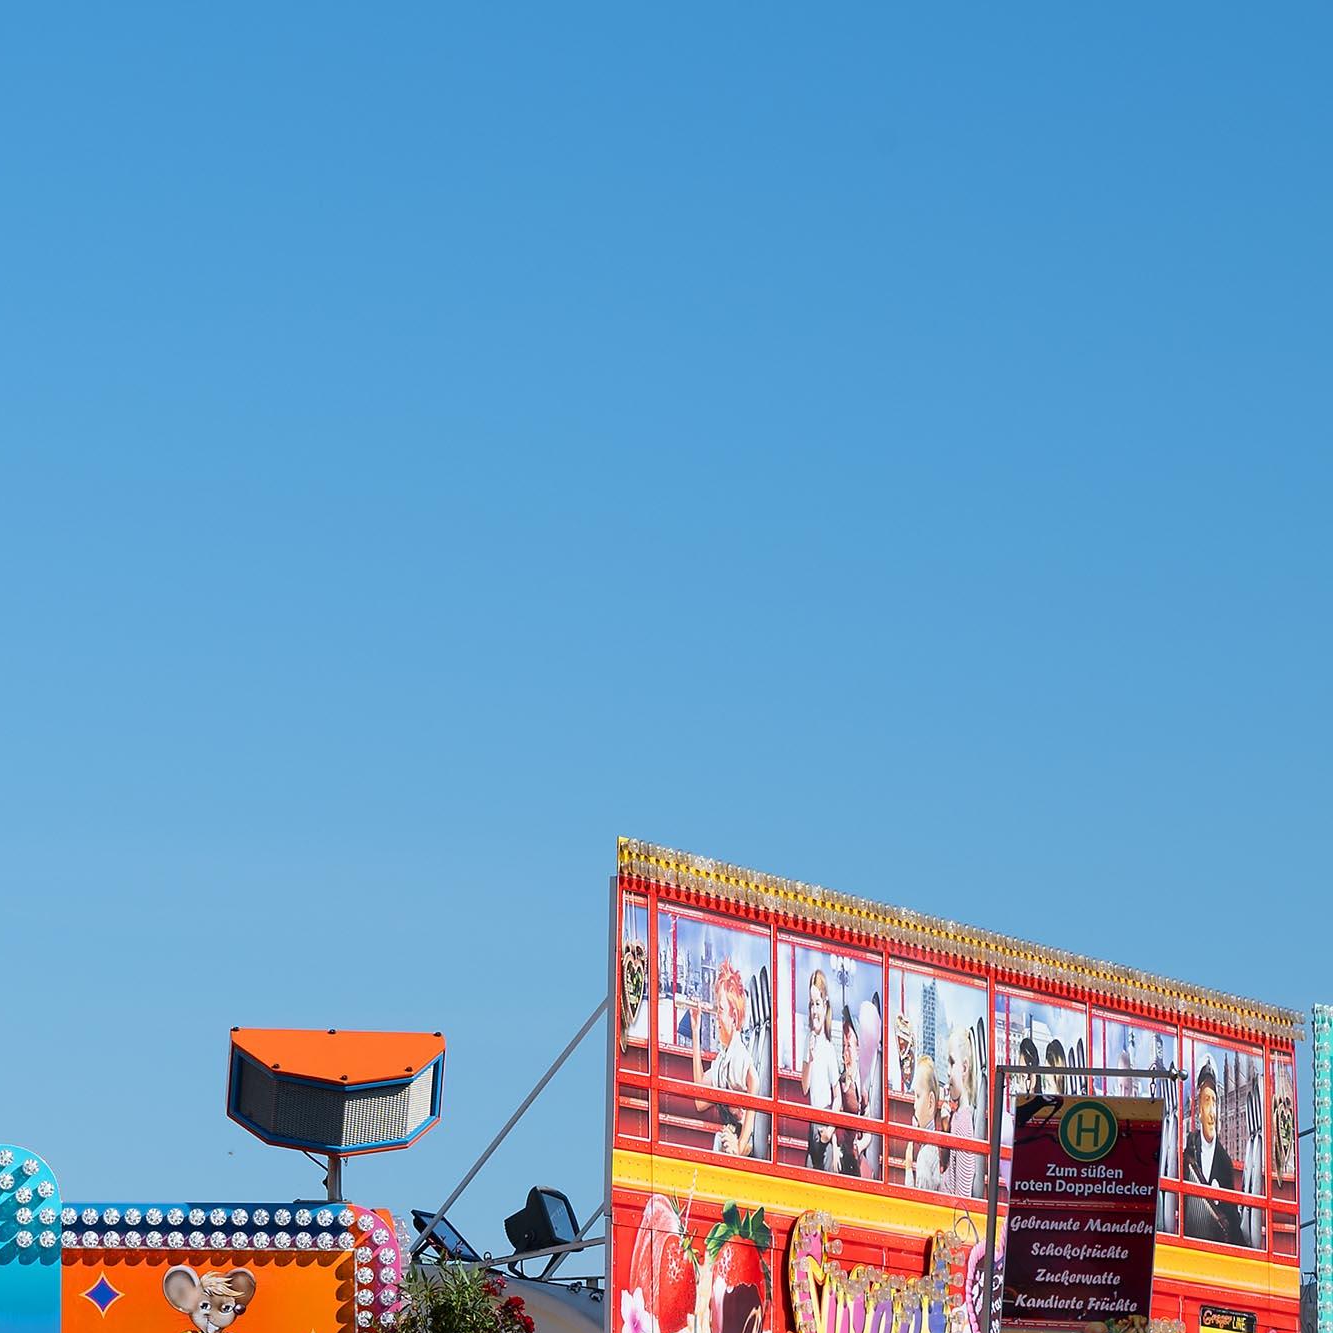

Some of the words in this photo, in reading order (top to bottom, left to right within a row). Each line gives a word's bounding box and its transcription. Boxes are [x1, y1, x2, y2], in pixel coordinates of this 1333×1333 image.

[1075, 1114, 1100, 1147] H
[1046, 1164, 1077, 1178] Zum
[1081, 1164, 1123, 1179] süßen
[1014, 1180, 1052, 1193] roten
[1055, 1180, 1154, 1196] Doppeldecker
[1010, 1216, 1080, 1231] Gebrannte
[1084, 1219, 1153, 1234] Mandeln
[1031, 1243, 1129, 1260] Schokofrüchte
[1035, 1269, 1121, 1286] Zuckerwatte
[1014, 1293, 1083, 1310] Kandierte
[1088, 1297, 1137, 1313] Früchte
